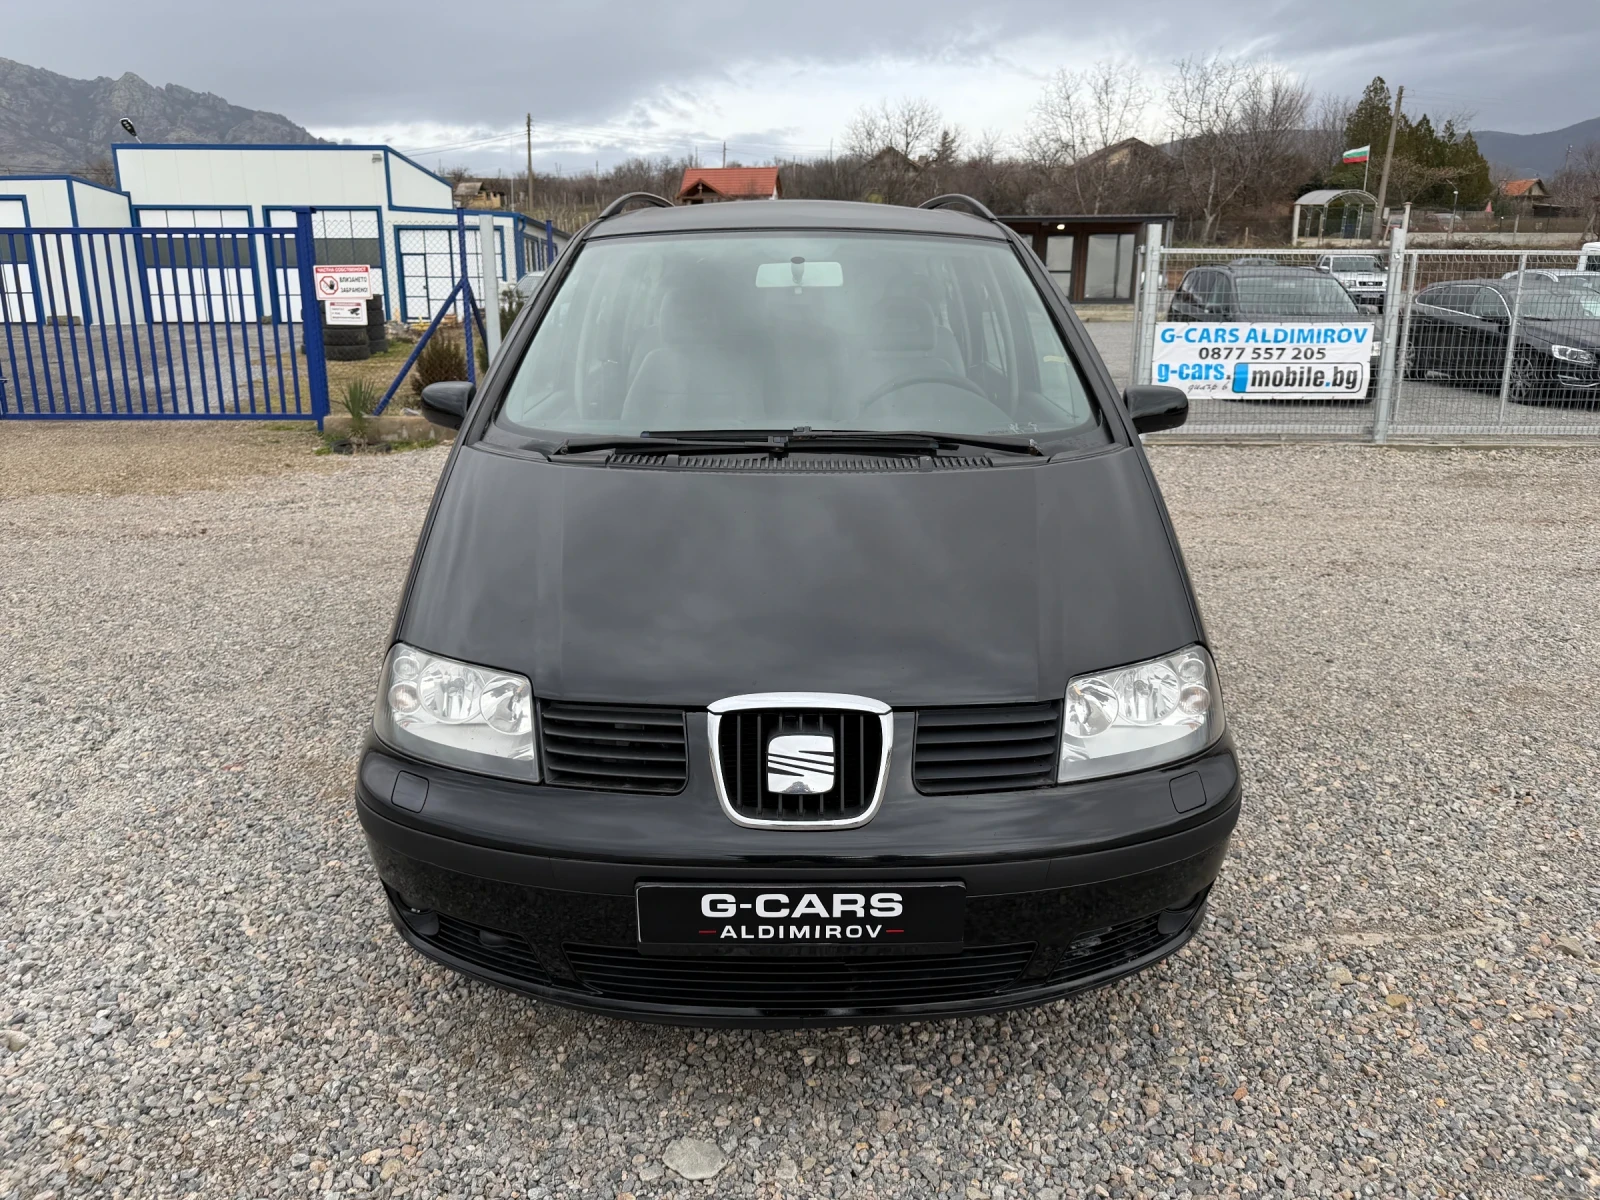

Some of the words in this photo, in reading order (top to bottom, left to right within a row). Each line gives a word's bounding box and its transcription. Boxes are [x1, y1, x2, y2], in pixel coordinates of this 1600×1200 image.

[1160, 328, 1240, 344] G-CARS
[1245, 328, 1368, 344] ALDIMIROV
[1198, 347, 1246, 360] 0877
[1251, 347, 1286, 360] 557
[1291, 347, 1326, 360] 205
[1251, 366, 1358, 390] mobile.bg
[701, 892, 904, 918] G-CARS
[719, 924, 883, 939] ALDIMIROV
